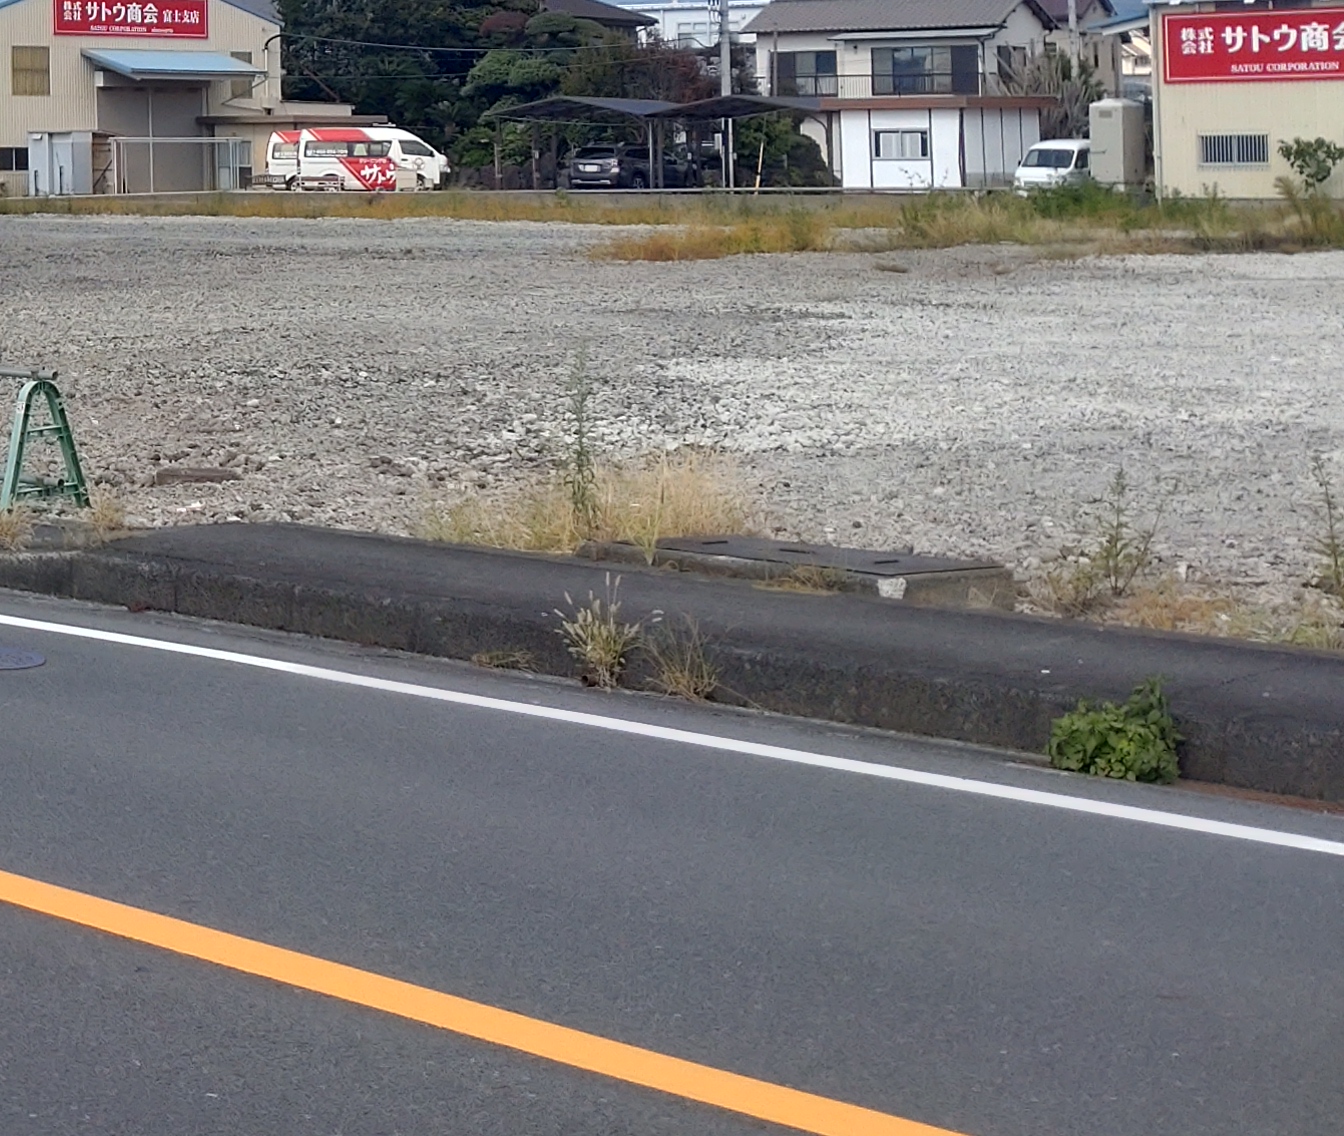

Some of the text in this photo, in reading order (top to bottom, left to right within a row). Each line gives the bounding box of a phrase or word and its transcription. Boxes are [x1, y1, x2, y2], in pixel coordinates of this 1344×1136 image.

[86, 2, 159, 24] サトウ商会
[163, 9, 200, 24] 富士支店
[1231, 61, 1340, 73] SATOU CORPORATION
[360, 163, 396, 184] サトウ
